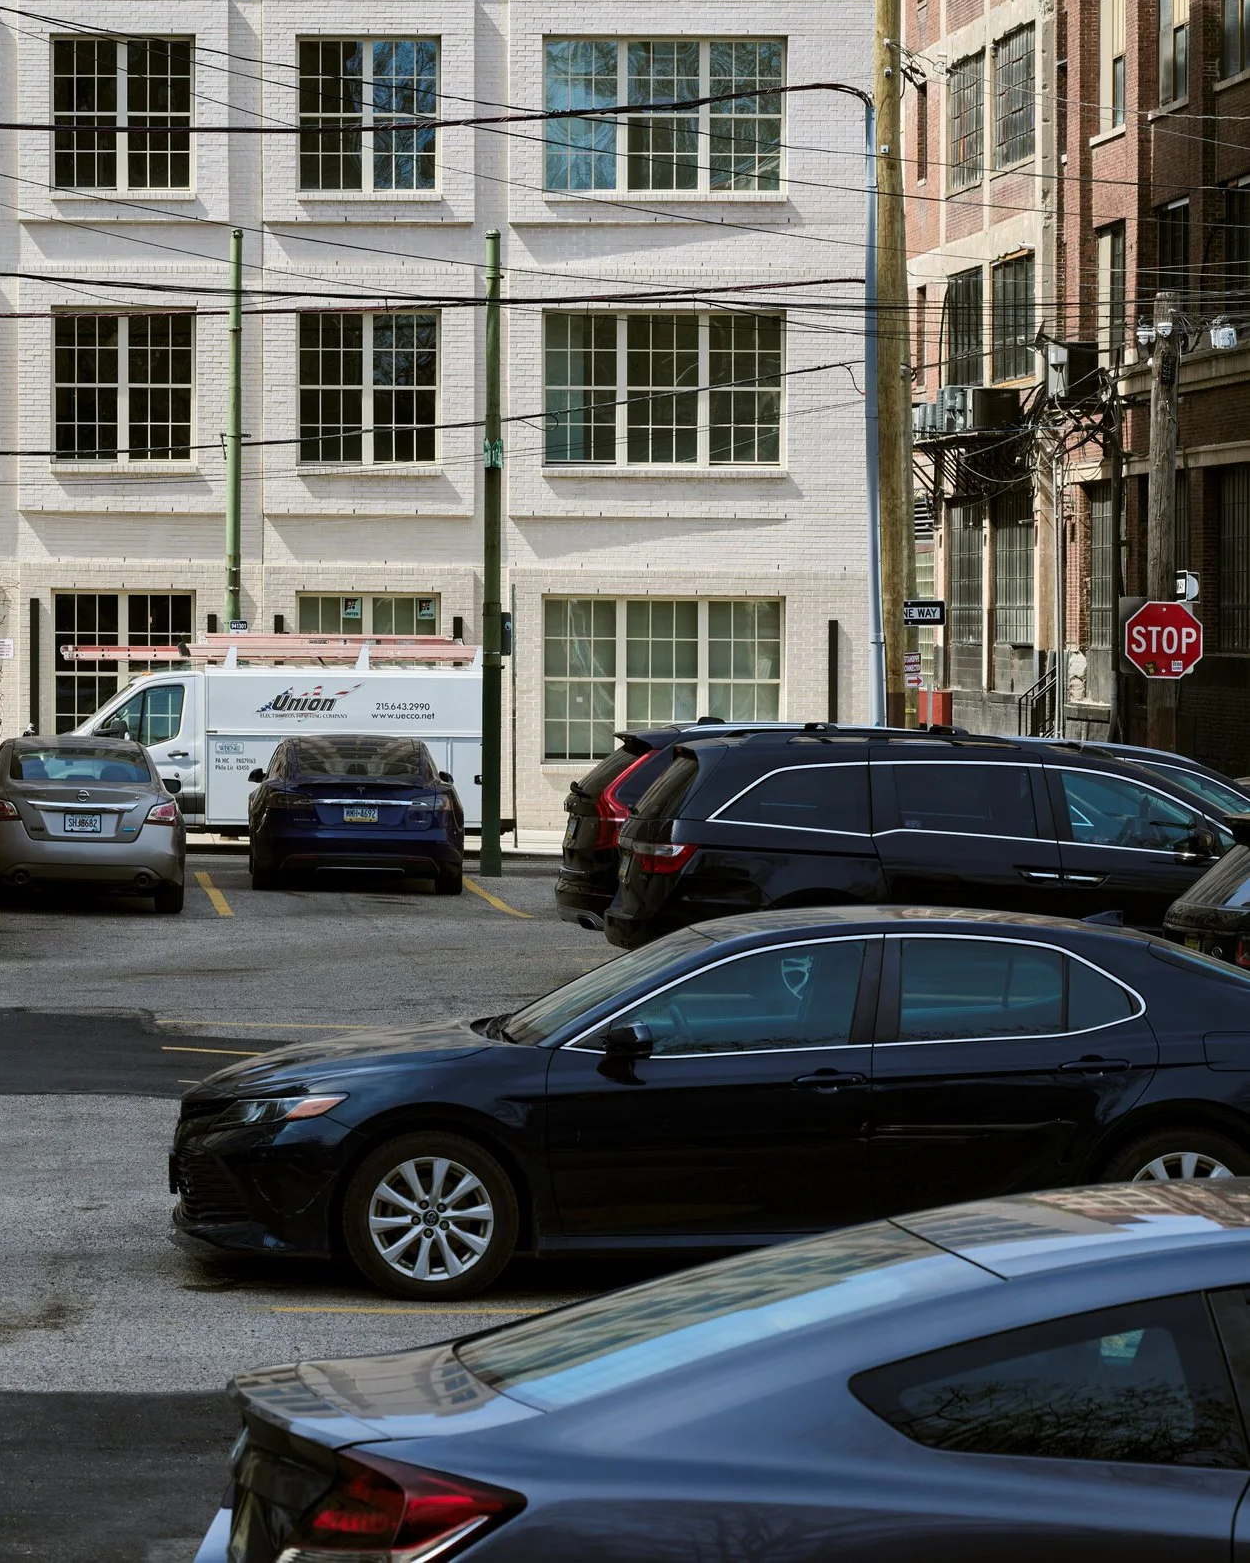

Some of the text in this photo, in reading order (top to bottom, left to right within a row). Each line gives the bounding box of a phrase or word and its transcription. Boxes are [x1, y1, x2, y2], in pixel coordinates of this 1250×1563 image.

[904, 609, 937, 618] NE WAY
[1131, 626, 1197, 654] STOP
[272, 695, 337, 711] Union
[375, 702, 430, 711] 215.643.2990
